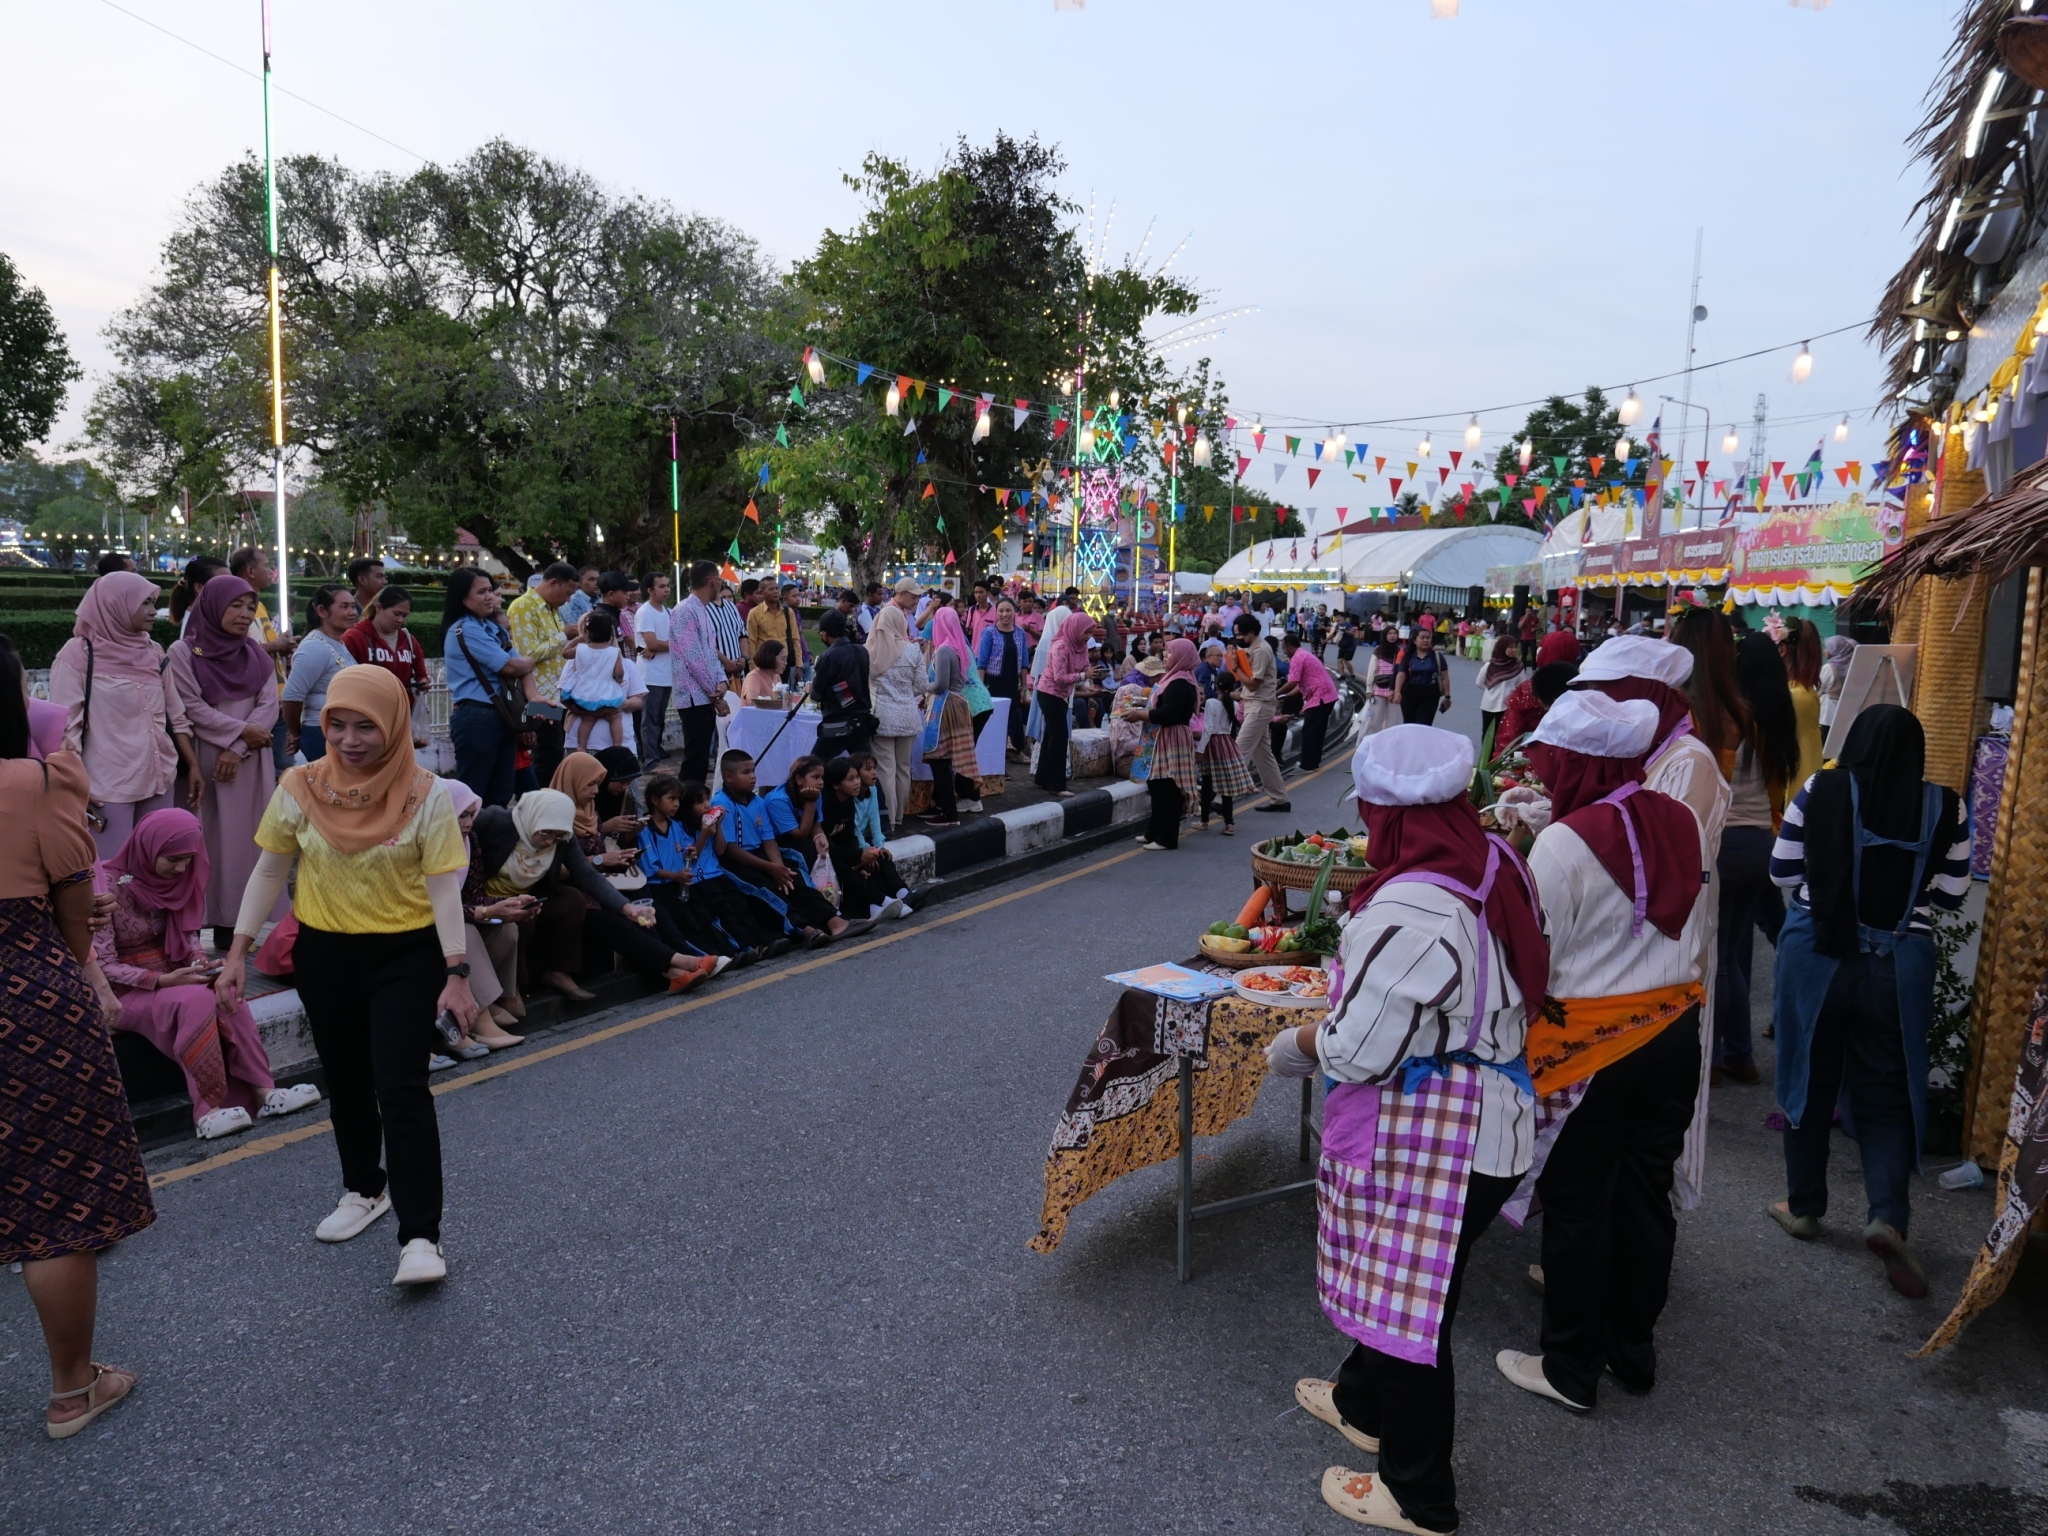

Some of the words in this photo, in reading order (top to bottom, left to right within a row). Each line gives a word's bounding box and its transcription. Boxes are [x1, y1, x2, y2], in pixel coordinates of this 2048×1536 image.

[1747, 536, 1885, 571] องค์การบริหารส่วนจังหวัดยะลา
